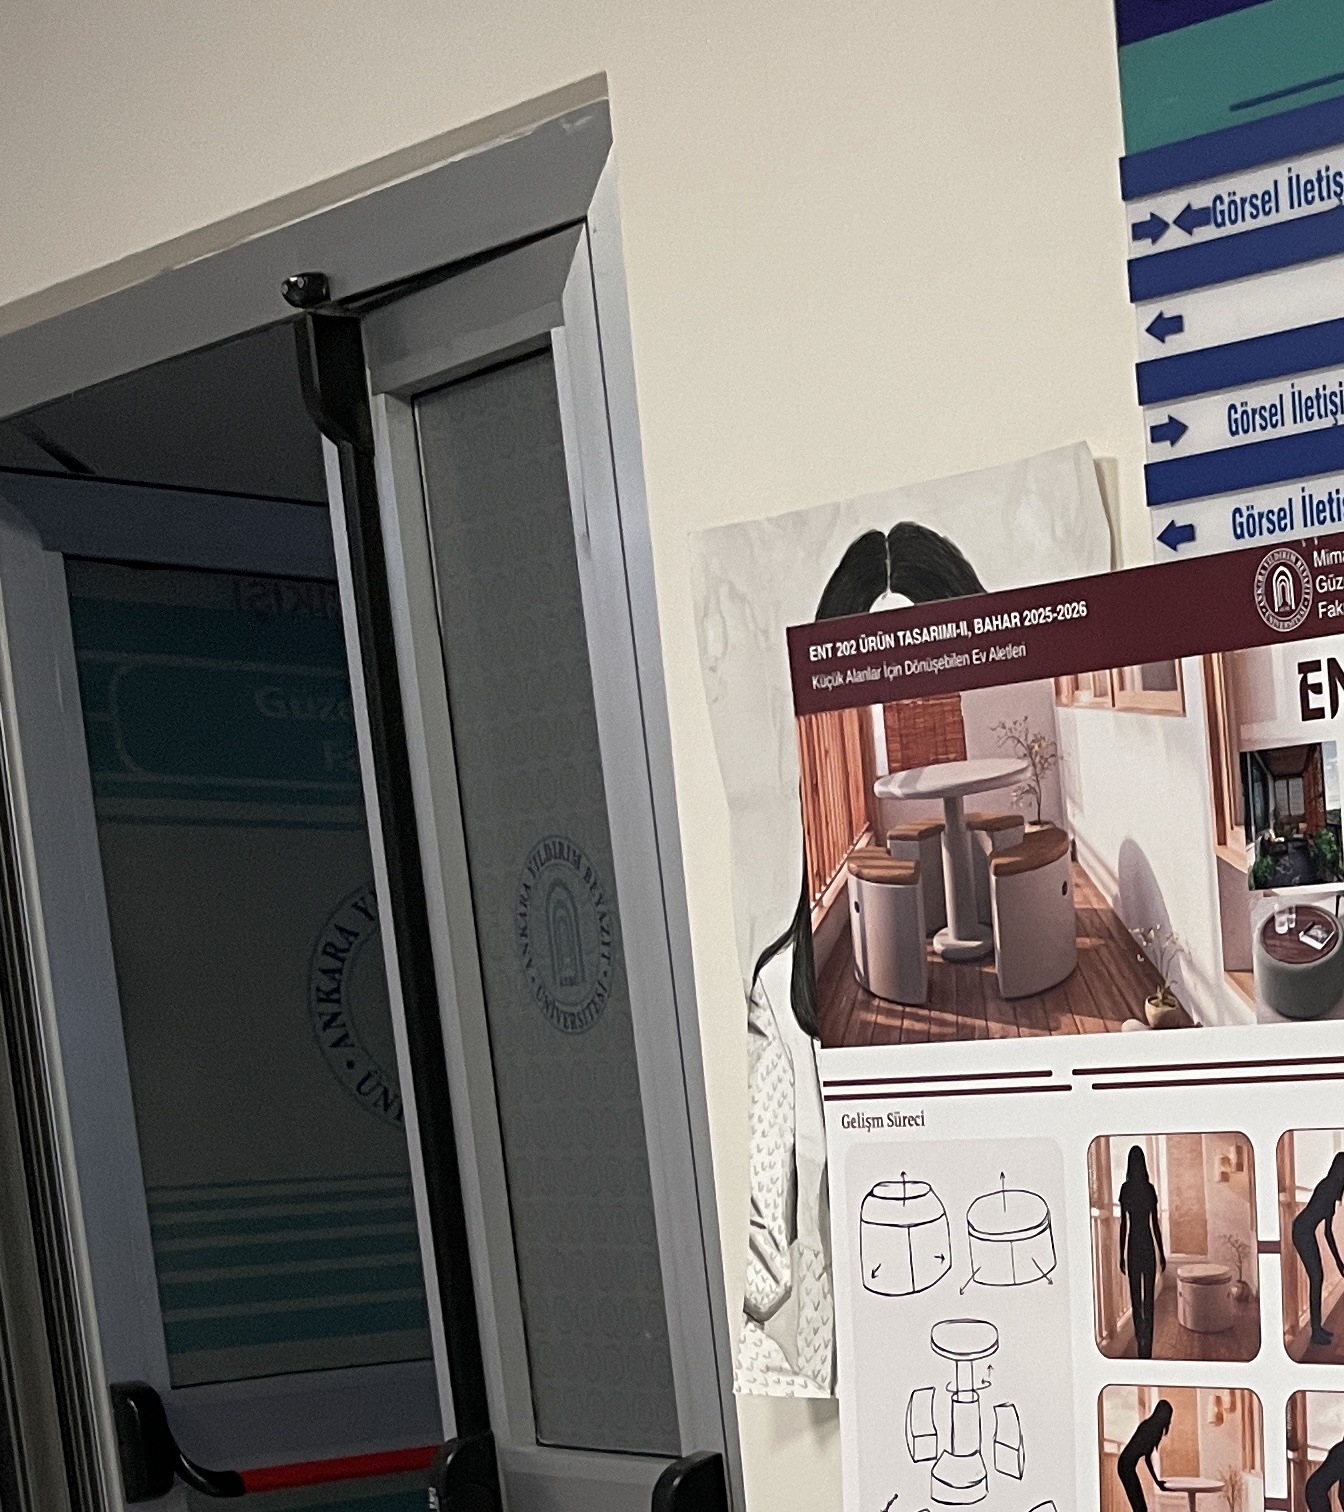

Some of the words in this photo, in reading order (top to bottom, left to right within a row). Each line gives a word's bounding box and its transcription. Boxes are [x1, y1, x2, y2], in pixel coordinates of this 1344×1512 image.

[1211, 179, 1280, 229] Görsel
[1227, 394, 1285, 438] Görsel
[1231, 497, 1295, 541] Görsel
[809, 643, 834, 661] ENT
[836, 639, 857, 657] 202
[859, 631, 895, 653] ÜRÜN
[973, 612, 1020, 635] BAHAR
[1023, 600, 1088, 627] 2025-2026
[972, 649, 987, 664] Ev
[315, 923, 360, 1049] ANKARA
[886, 1110, 925, 1128] Süreci
